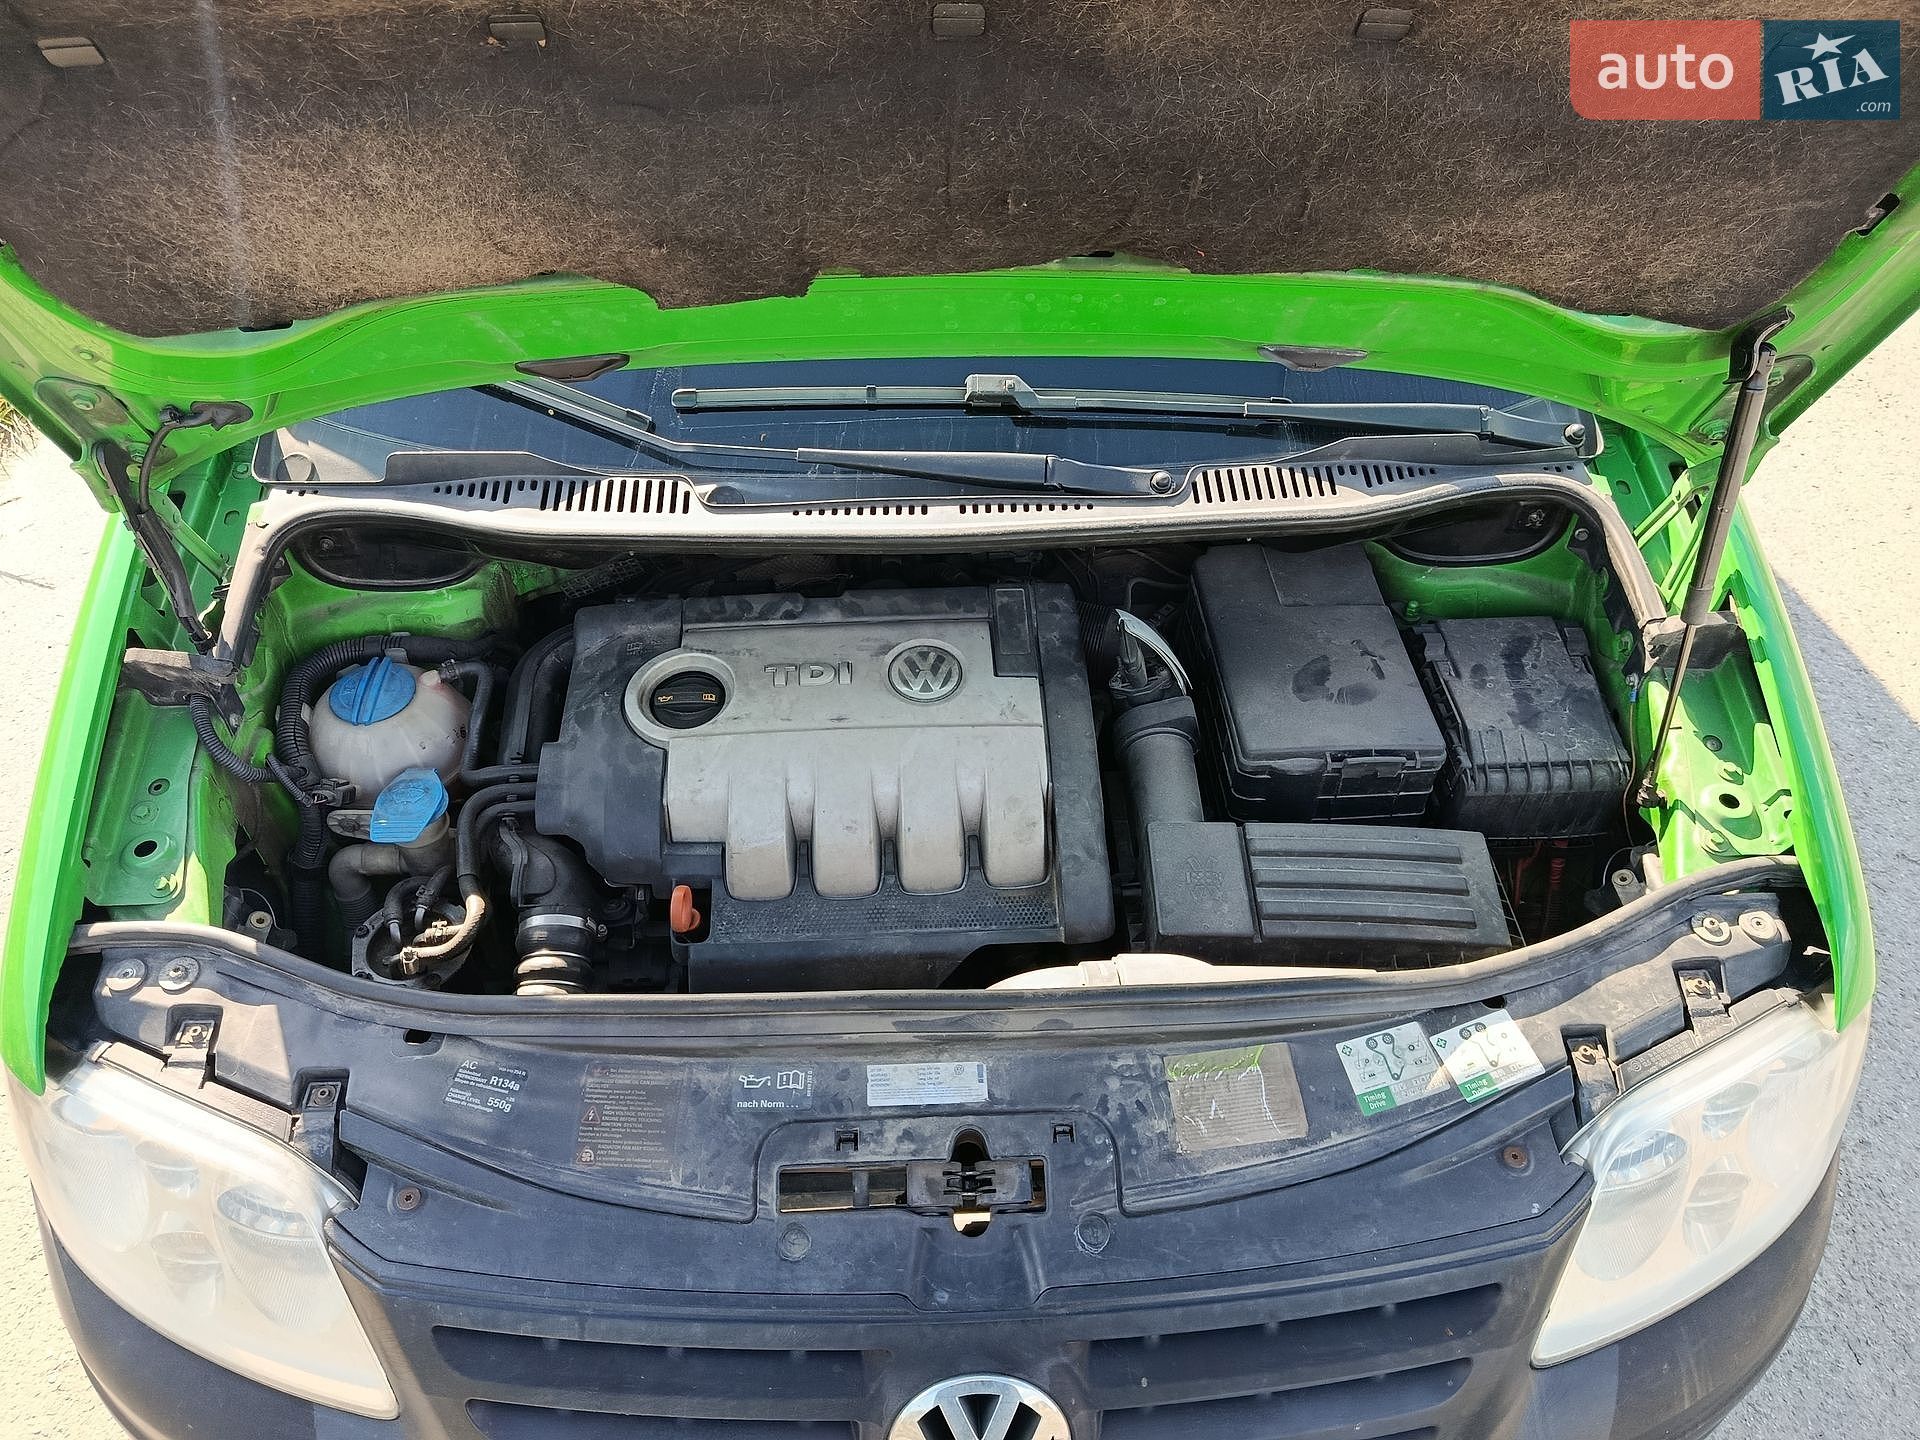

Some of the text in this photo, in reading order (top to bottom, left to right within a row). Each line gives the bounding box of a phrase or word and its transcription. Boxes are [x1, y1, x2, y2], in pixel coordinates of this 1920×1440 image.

[764, 661, 852, 687] TDI
[461, 1060, 478, 1069] AC
[490, 1076, 520, 1091] R134a
[1465, 1078, 1488, 1092] Timing
[1363, 1090, 1387, 1103] Timing
[487, 1097, 512, 1113] 550g
[737, 1100, 758, 1108] nach
[1369, 1100, 1387, 1110] Drive
